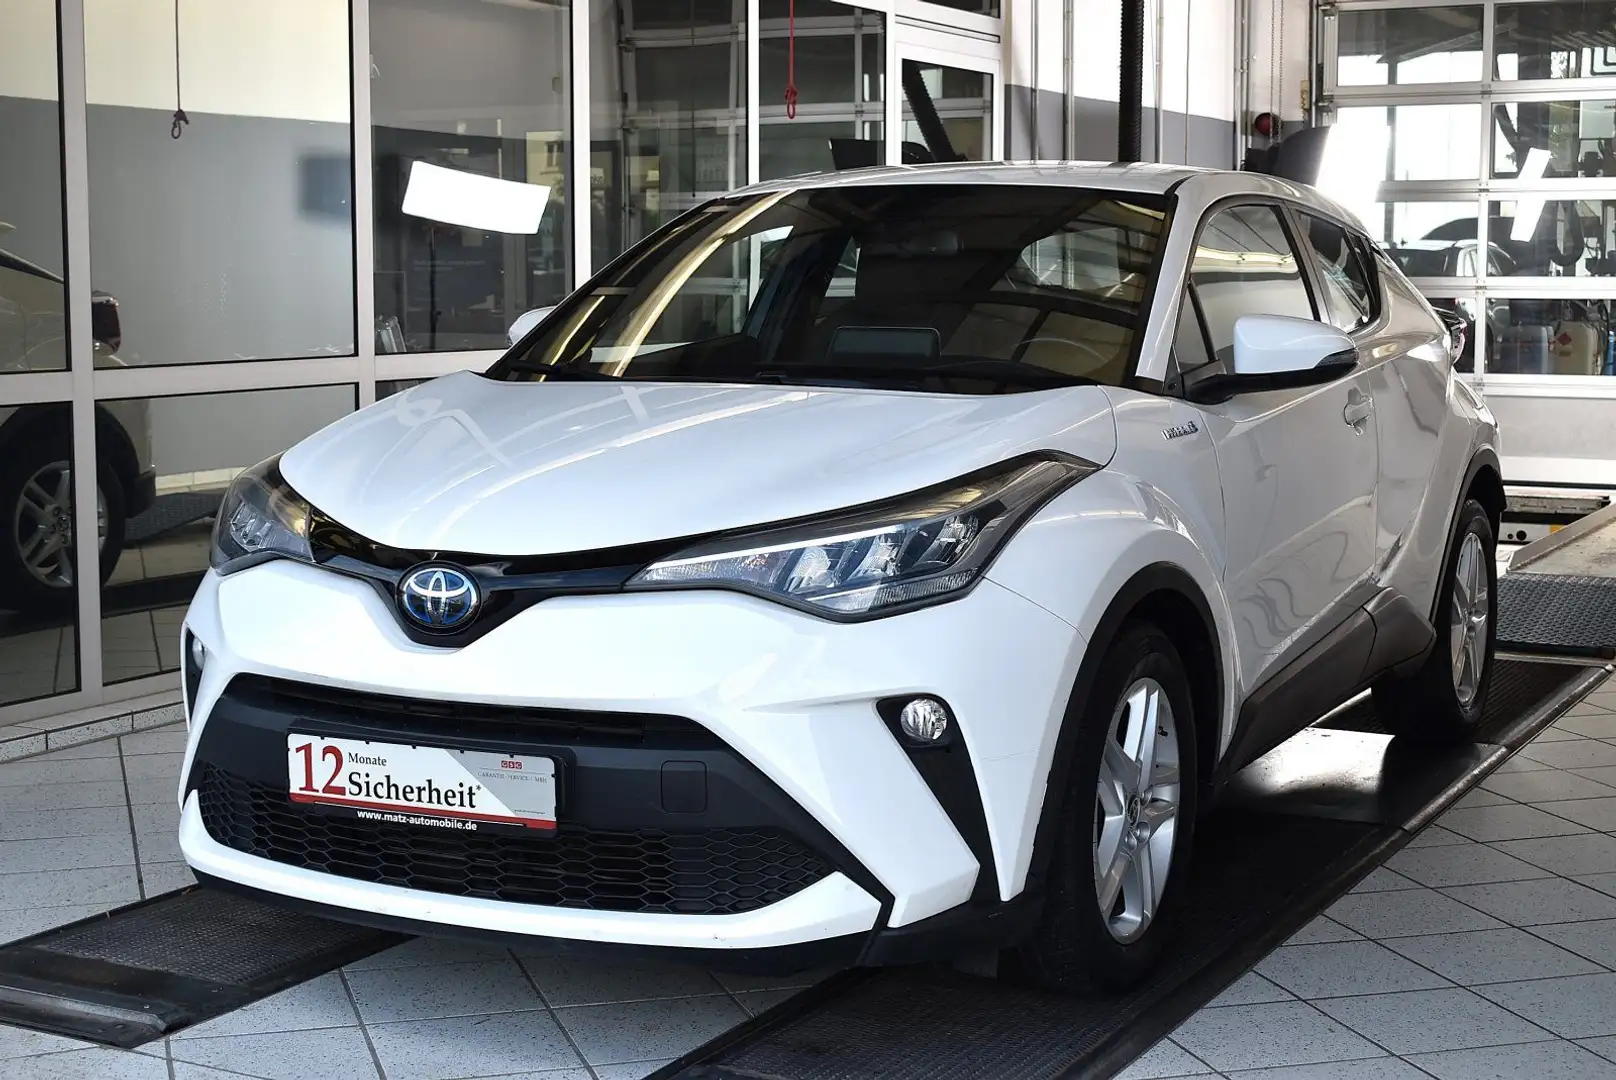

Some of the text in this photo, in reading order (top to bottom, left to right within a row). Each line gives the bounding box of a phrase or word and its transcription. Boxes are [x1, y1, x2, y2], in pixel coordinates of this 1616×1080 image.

[295, 742, 346, 795] 12
[348, 752, 387, 767] Monate
[357, 809, 477, 831] www.matz-automobile.de
